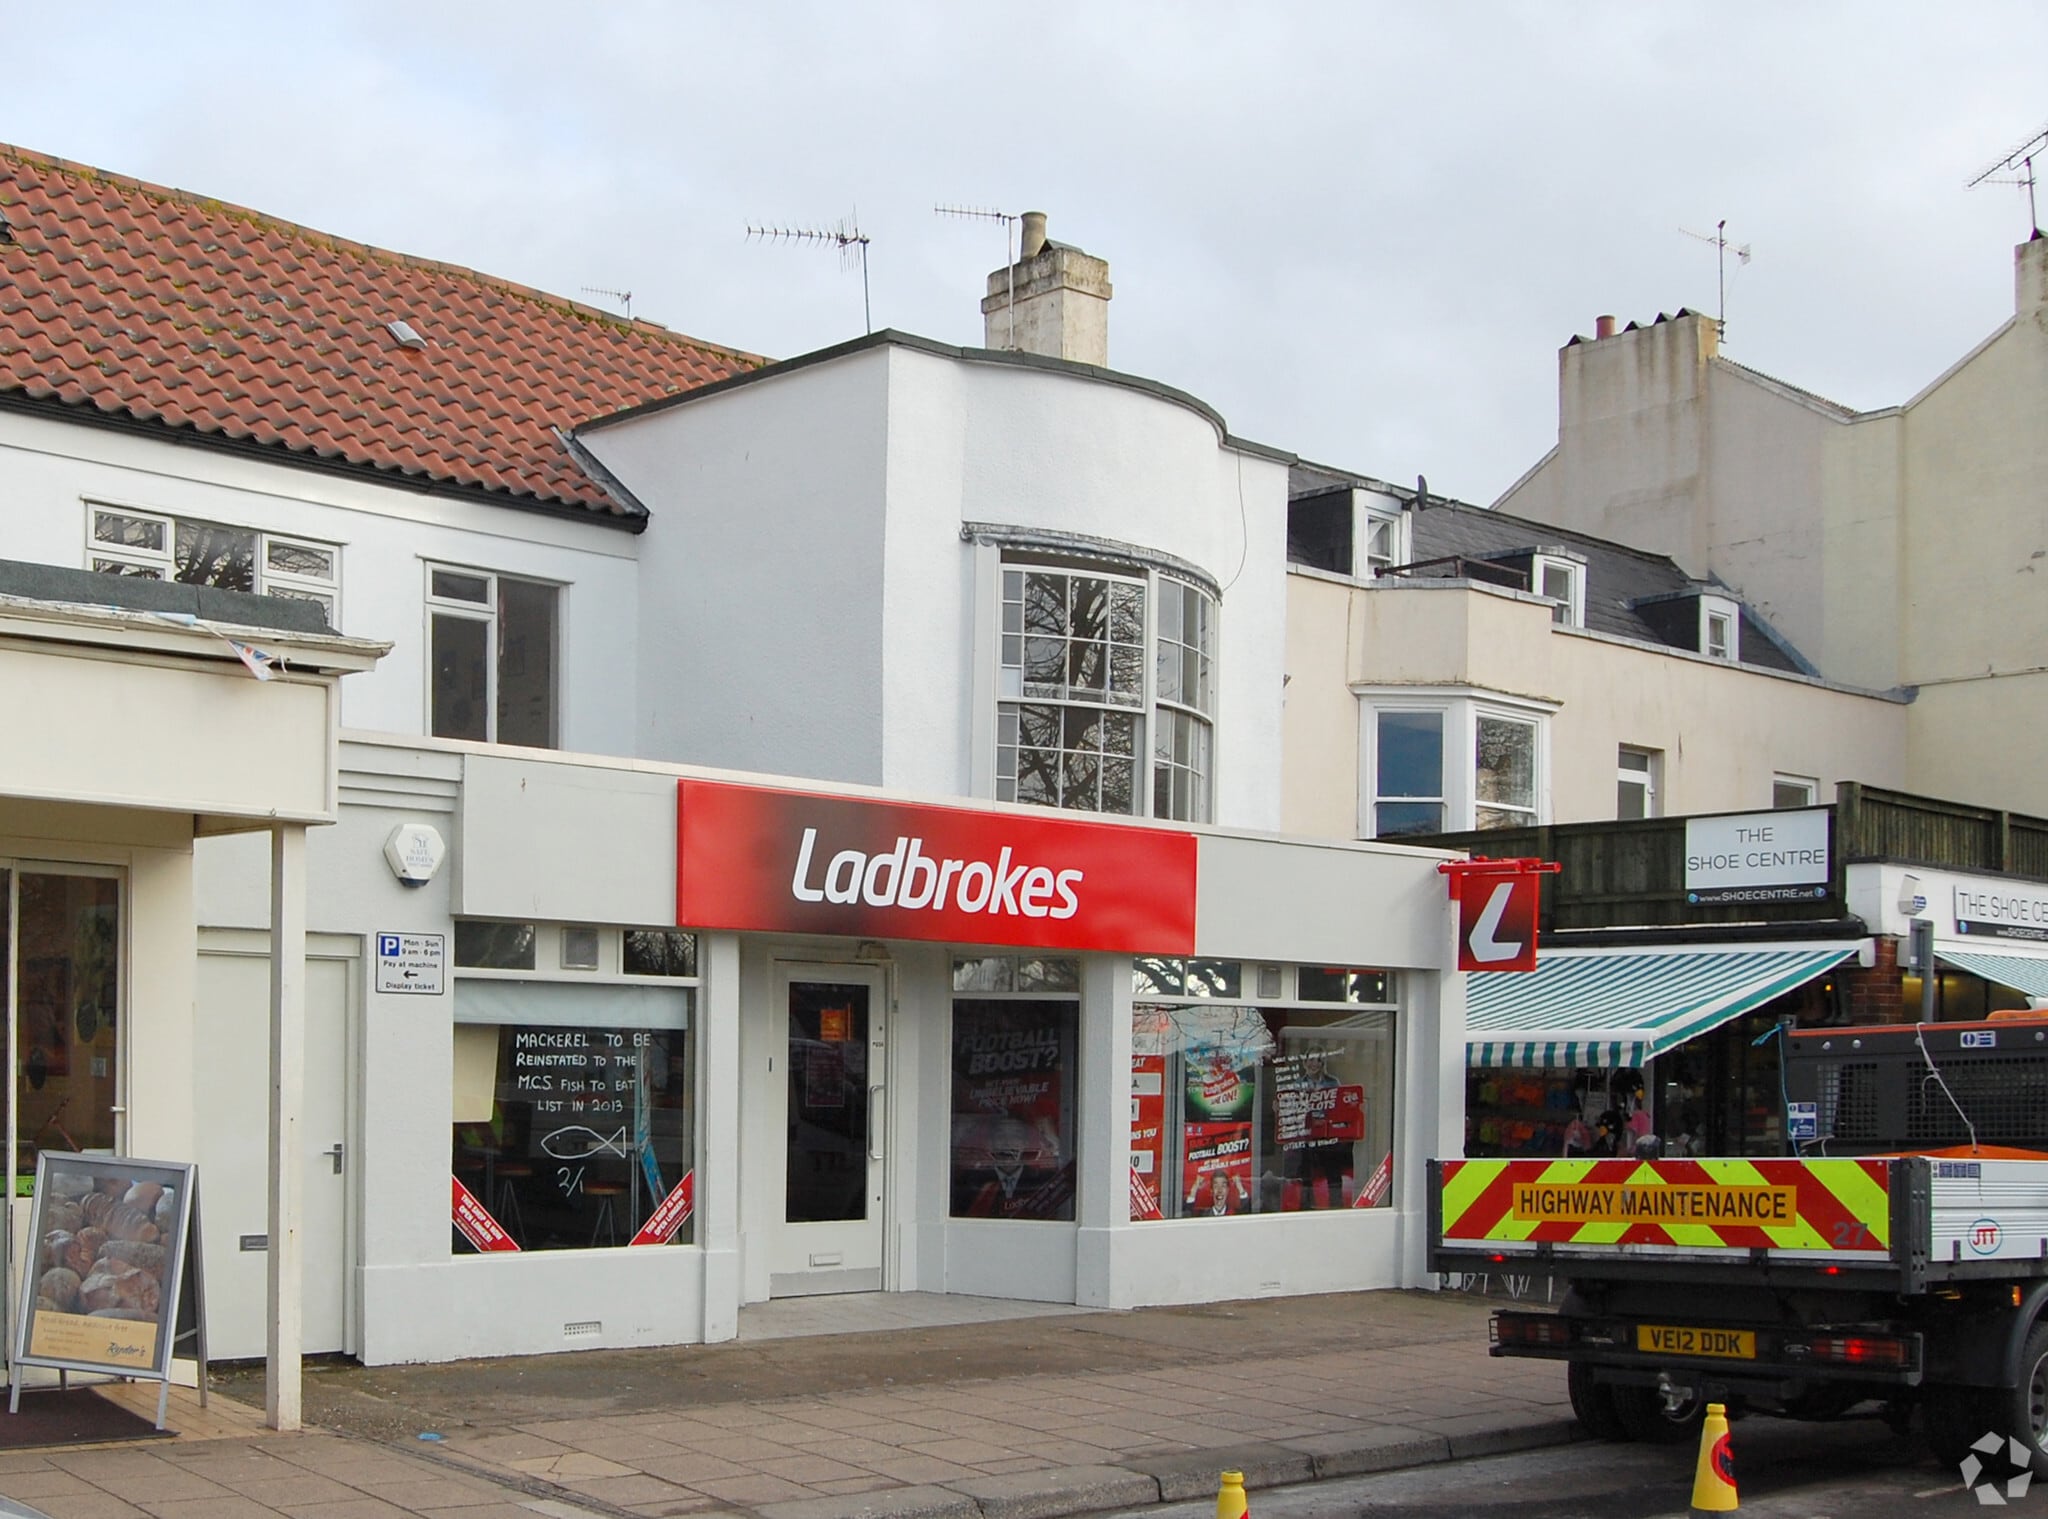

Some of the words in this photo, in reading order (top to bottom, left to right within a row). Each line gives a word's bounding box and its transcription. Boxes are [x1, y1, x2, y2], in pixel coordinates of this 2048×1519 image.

[1736, 827, 1774, 843] THE
[1687, 854, 1740, 872] SHOE
[1746, 849, 1825, 868] CENTRE
[792, 828, 1083, 919] Ladbrokes
[1700, 888, 1814, 902] www.SHOECENTRE.net
[1959, 892, 1987, 916] THE
[1990, 896, 2029, 921] SHOE
[1469, 882, 1522, 962] L
[385, 937, 398, 955] P
[404, 939, 419, 947] Mon
[425, 940, 440, 948] Sun
[384, 960, 396, 968] Pay
[409, 961, 438, 969] machine
[386, 982, 412, 990] Display
[414, 983, 435, 991] ticket
[516, 1033, 589, 1048] MACKEREL
[605, 1033, 623, 1047] TO
[633, 1033, 651, 1047] BE
[516, 1052, 587, 1067] REINSTATED
[594, 1055, 606, 1067] TO
[614, 1055, 637, 1067] THE
[968, 1048, 1058, 1075] BOOST?
[561, 1079, 584, 1092] FISH
[590, 1080, 606, 1091] TO
[616, 1079, 636, 1092] EAT
[538, 1101, 563, 1112] LIST
[572, 1101, 584, 1112] IN
[592, 1099, 623, 1112] 2013
[1217, 1138, 1250, 1156] BOOST?
[1520, 1189, 1613, 1215] HIGHWAY
[1621, 1190, 1787, 1219] MAINTENANCE
[1833, 1222, 1868, 1246] 27
[1651, 1329, 1695, 1350] VE12
[1700, 1333, 1741, 1354] DDK
